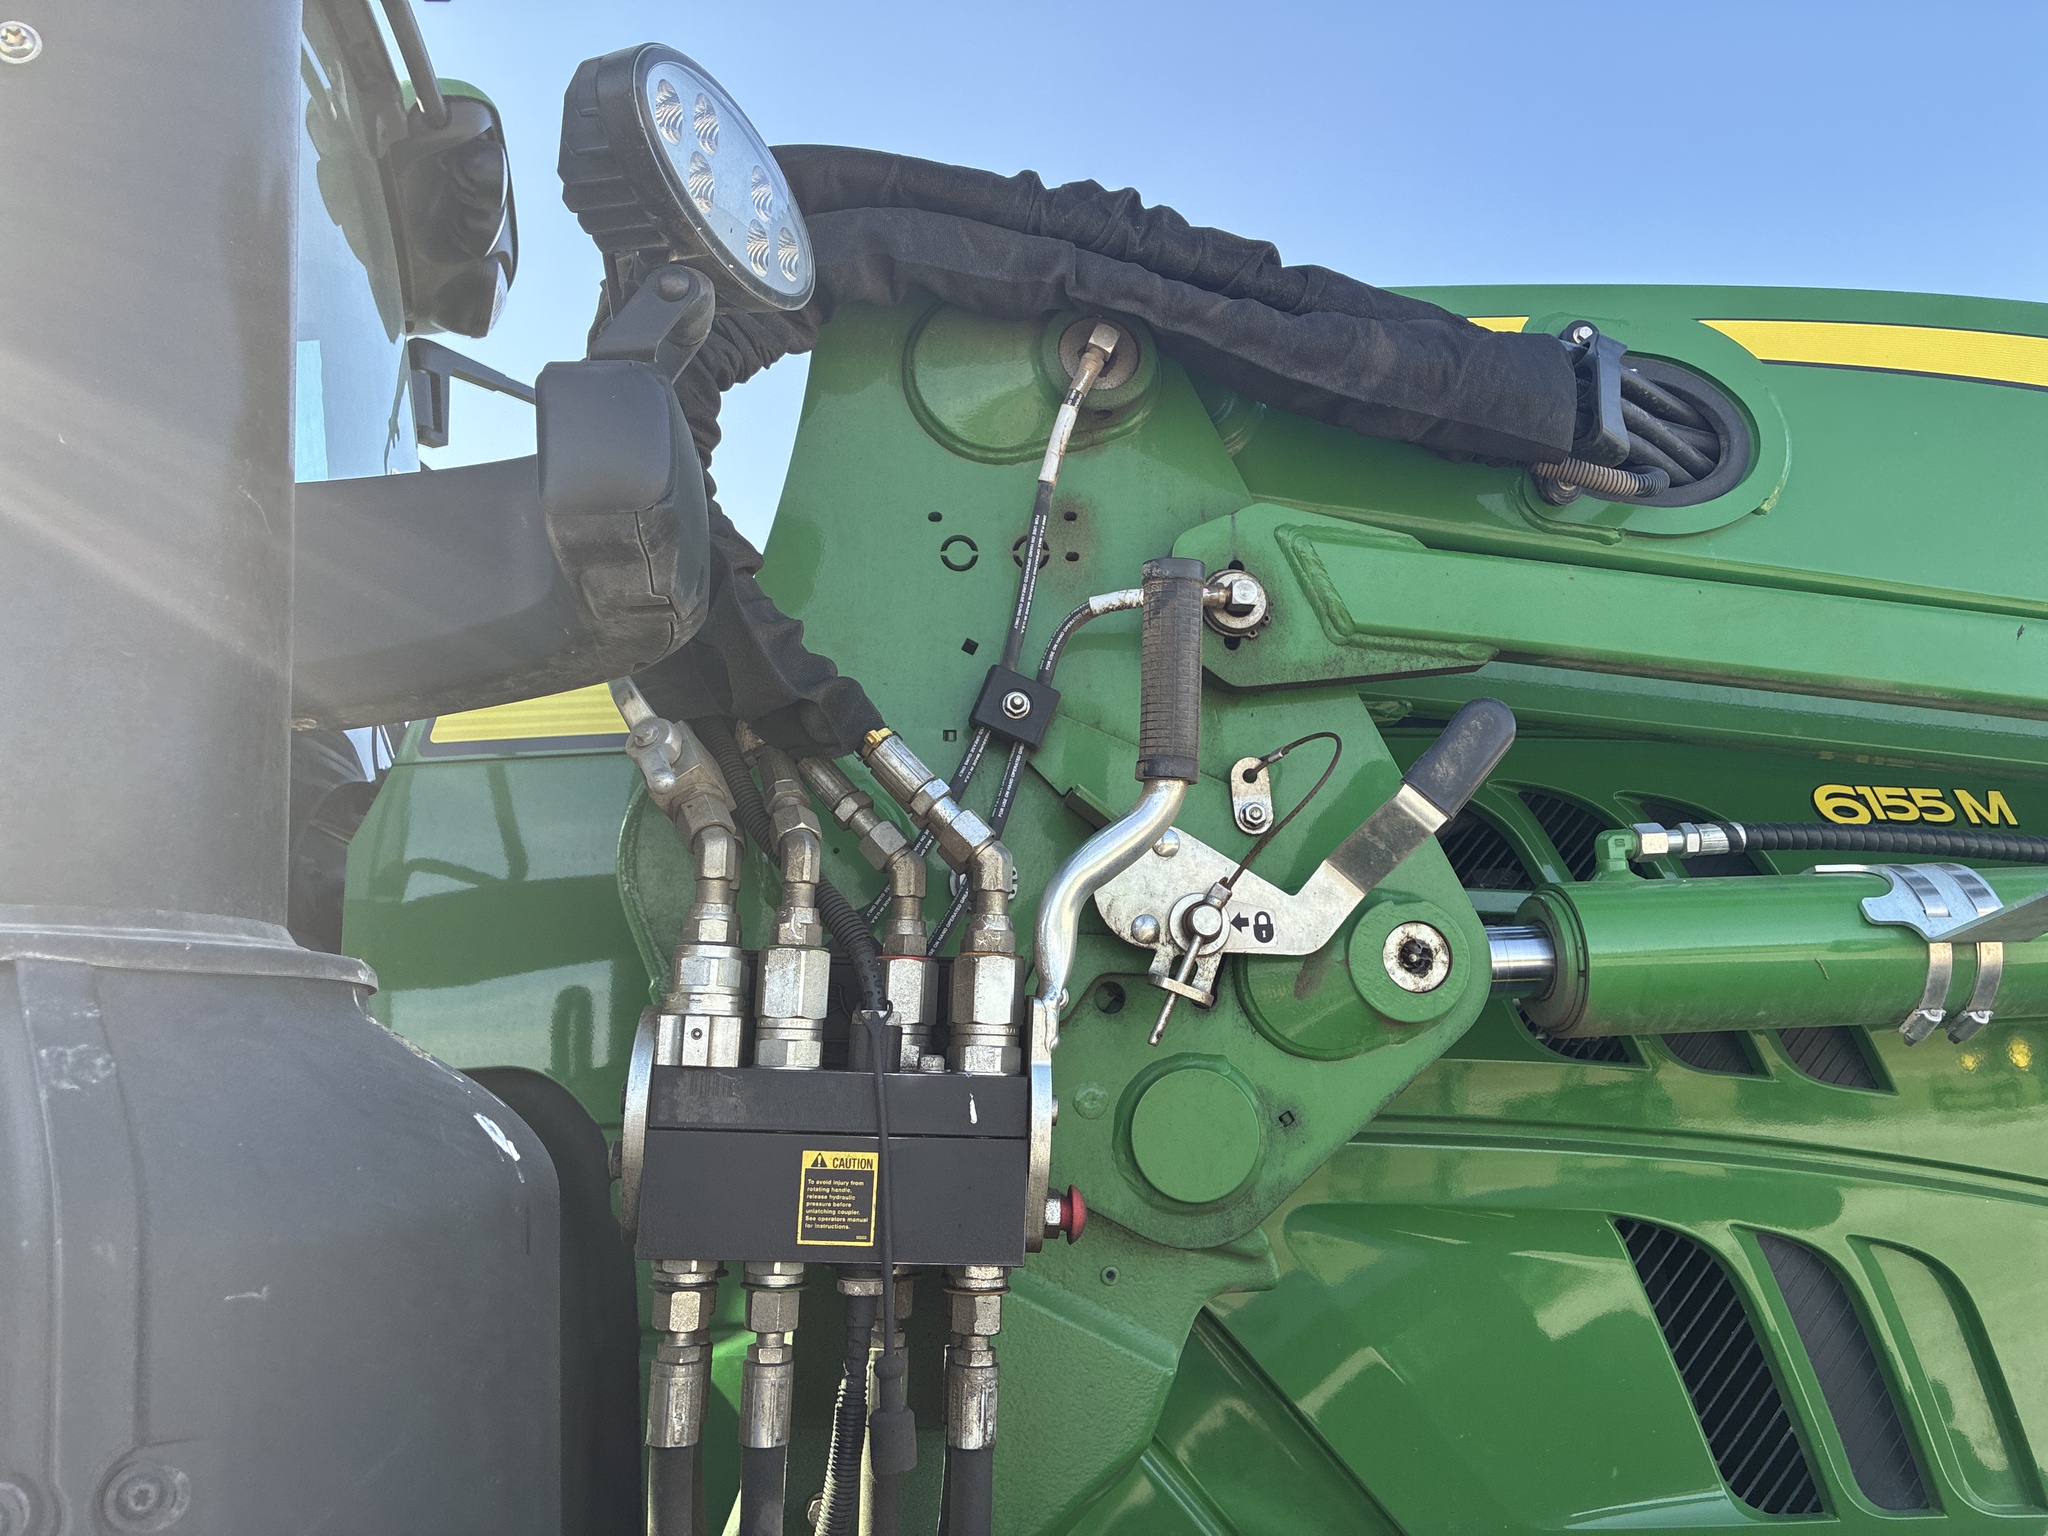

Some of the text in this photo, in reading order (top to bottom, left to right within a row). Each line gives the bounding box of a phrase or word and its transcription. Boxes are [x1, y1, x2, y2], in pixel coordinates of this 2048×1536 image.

[1056, 632, 1064, 644] HAND
[1063, 613, 1082, 632] OPERATED
[970, 735, 980, 753] GREASE
[964, 753, 972, 765] GUNS
[972, 753, 980, 766] MADE
[1011, 755, 1021, 777] OPERATED
[867, 893, 885, 917] GUNS ONLY
[938, 928, 948, 941] HAND
[946, 904, 962, 927] OPERATED
[833, 1157, 873, 1169] CAUTION
